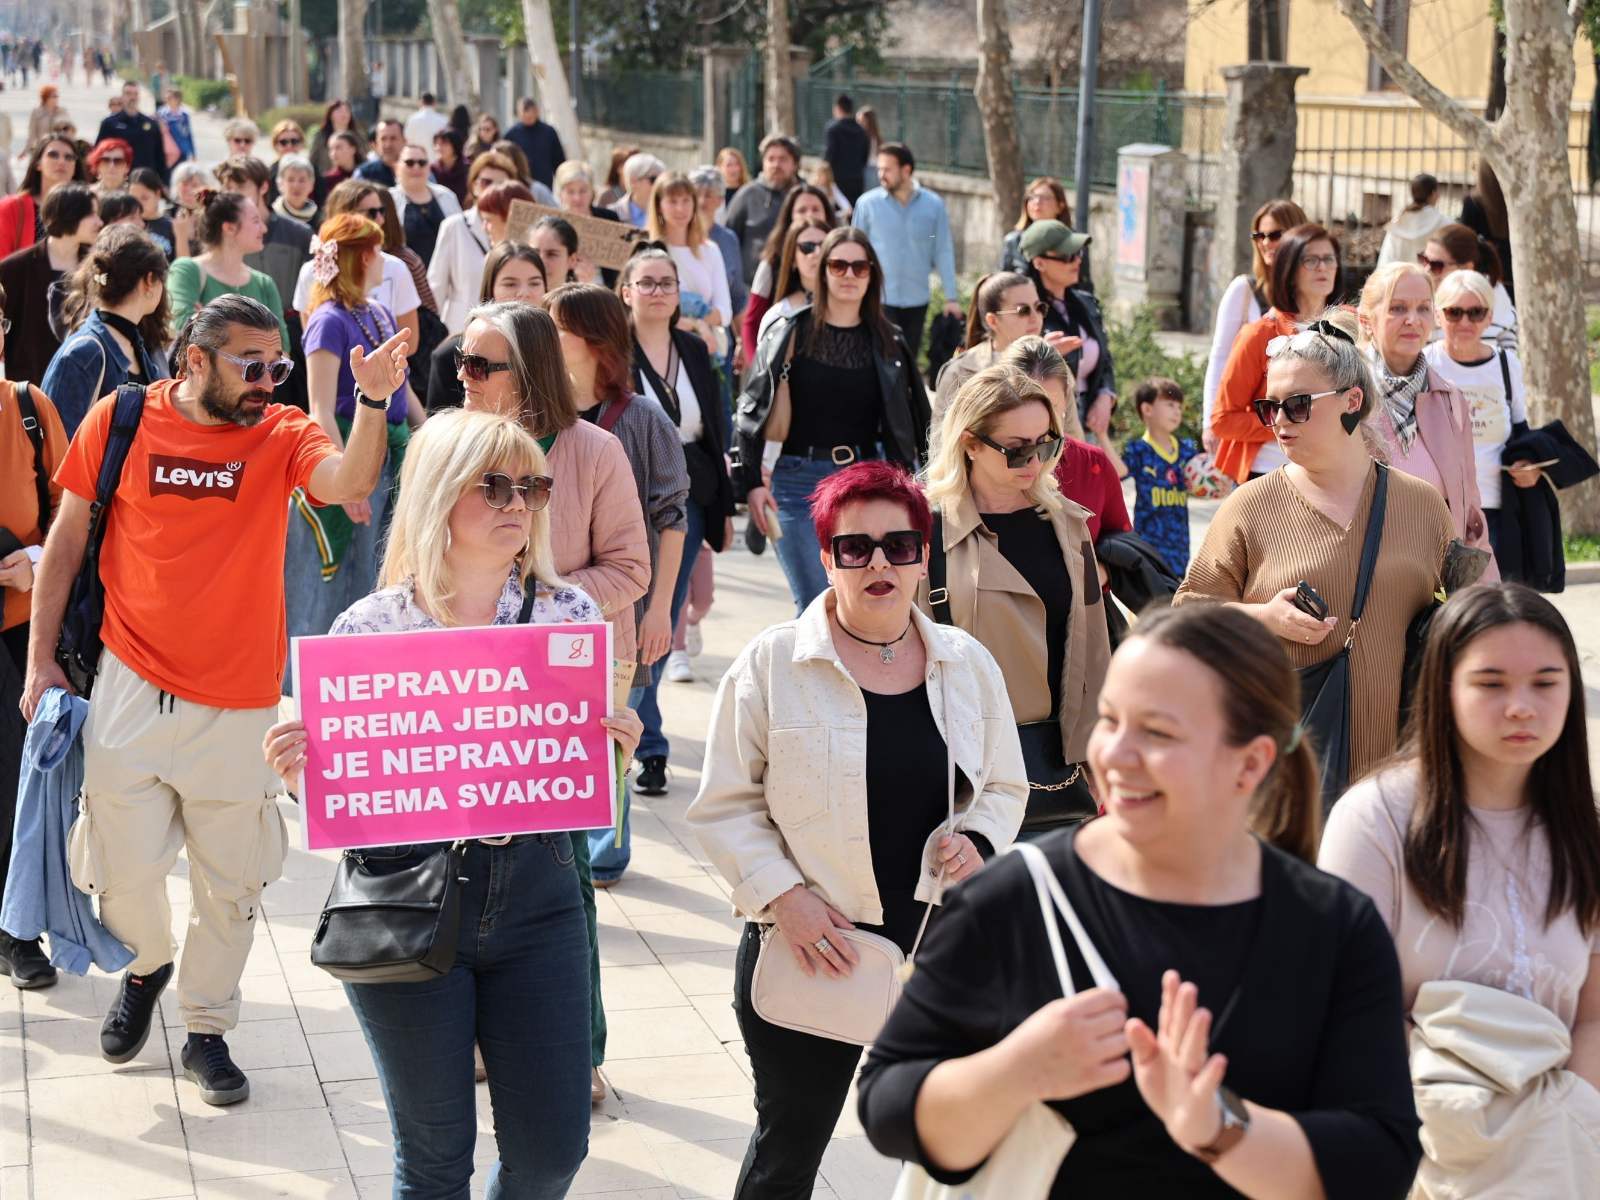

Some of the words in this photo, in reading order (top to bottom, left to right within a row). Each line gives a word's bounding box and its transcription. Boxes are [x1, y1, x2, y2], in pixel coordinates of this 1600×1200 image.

[319, 666, 529, 703] NEPRAVDA
[320, 709, 443, 741] PREMA
[452, 701, 589, 732] JEDNOJ
[322, 750, 370, 780] JE
[382, 736, 589, 776] NEPRAVDA
[325, 786, 448, 819] PREMA
[458, 775, 595, 808] SVAKOJ
